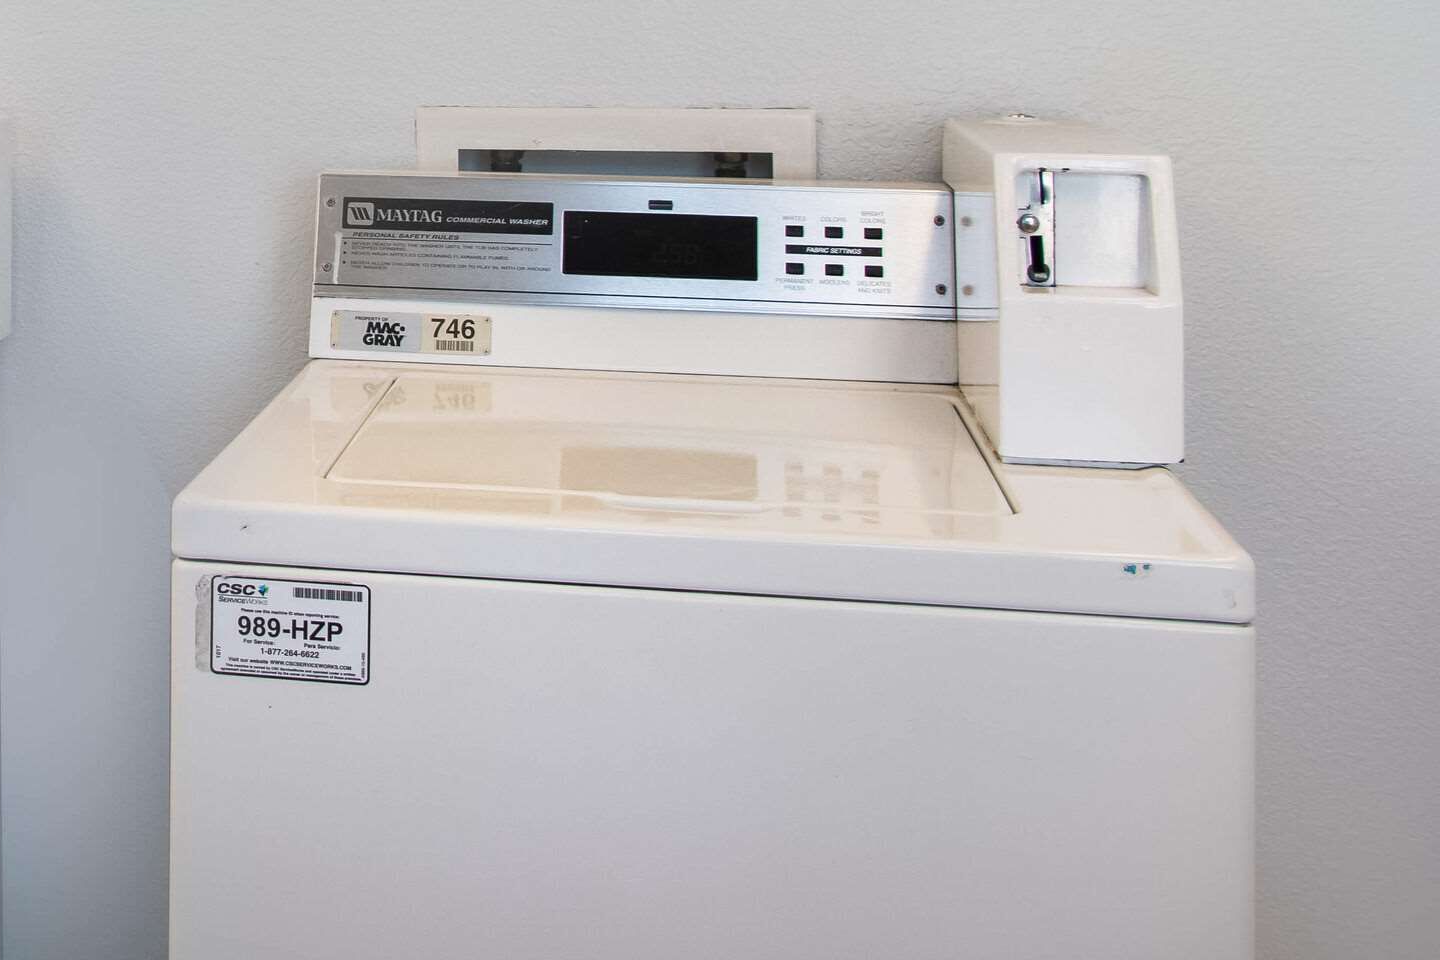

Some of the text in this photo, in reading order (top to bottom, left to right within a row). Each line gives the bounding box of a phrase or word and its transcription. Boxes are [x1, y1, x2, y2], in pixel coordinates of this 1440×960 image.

[376, 208, 442, 223] MAYTAG
[446, 216, 548, 226] COMMERCIAL WASHER
[431, 318, 475, 339] 746
[363, 334, 405, 347] GRAY
[217, 583, 256, 595] CSC
[238, 615, 343, 642] 989-HZP
[260, 647, 320, 658] 1-877-264-6622
